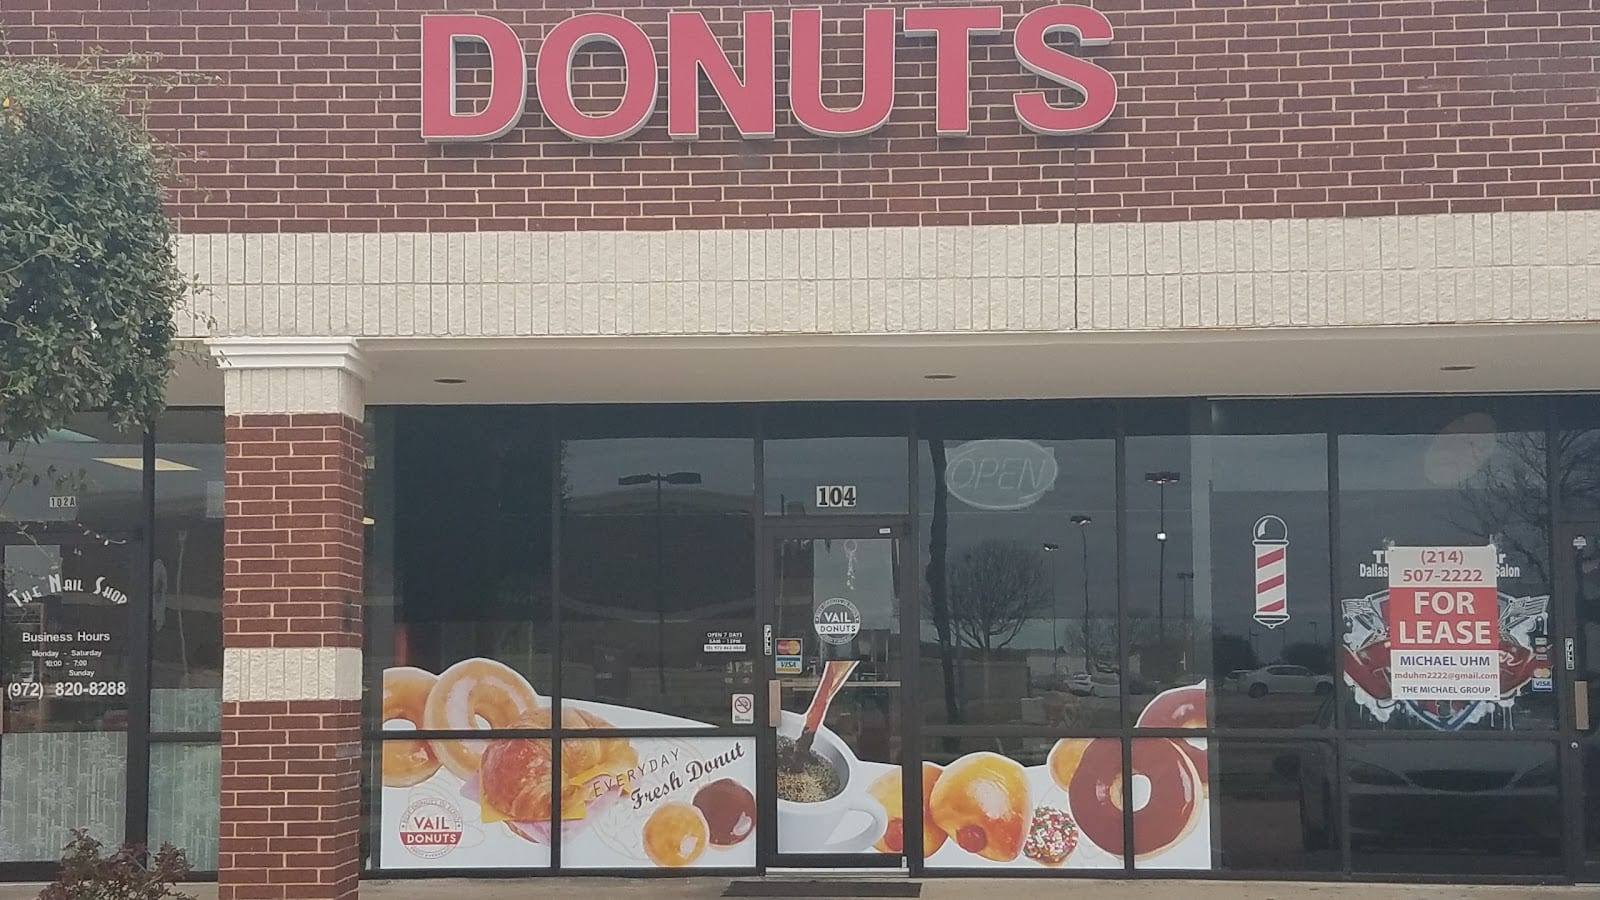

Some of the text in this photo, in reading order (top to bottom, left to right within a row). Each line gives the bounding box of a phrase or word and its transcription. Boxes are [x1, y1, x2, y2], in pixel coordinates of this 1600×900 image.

[420, 4, 1119, 142] DONUTS
[951, 458, 1046, 490] OPEN
[51, 497, 75, 507] 102A
[818, 487, 855, 507] 104
[1421, 551, 1464, 565] (214)
[1359, 564, 1388, 578] Dallas
[1403, 569, 1483, 583] 507-2222
[1414, 591, 1476, 615] FOR
[823, 611, 851, 623] VAIL
[820, 625, 856, 633] DONUTS
[1399, 621, 1492, 645] LEASE
[22, 631, 111, 642] Business Hours
[31, 650, 60, 658] Monday
[70, 650, 102, 658] Saturday
[1400, 655, 1457, 666] MICHAEL
[1459, 655, 1490, 666] UHM
[68, 669, 95, 677] Sunday
[1394, 671, 1498, 681] mduhm2222@gmail.com
[7, 681, 127, 700] (972) 820-8288
[1401, 686, 1491, 694] THE MICHAEL GROUP
[593, 748, 680, 797] EVERYDAY
[631, 741, 745, 811] Fresh Donut
[413, 816, 450, 830] VAIL
[407, 833, 457, 844] DONUTS
